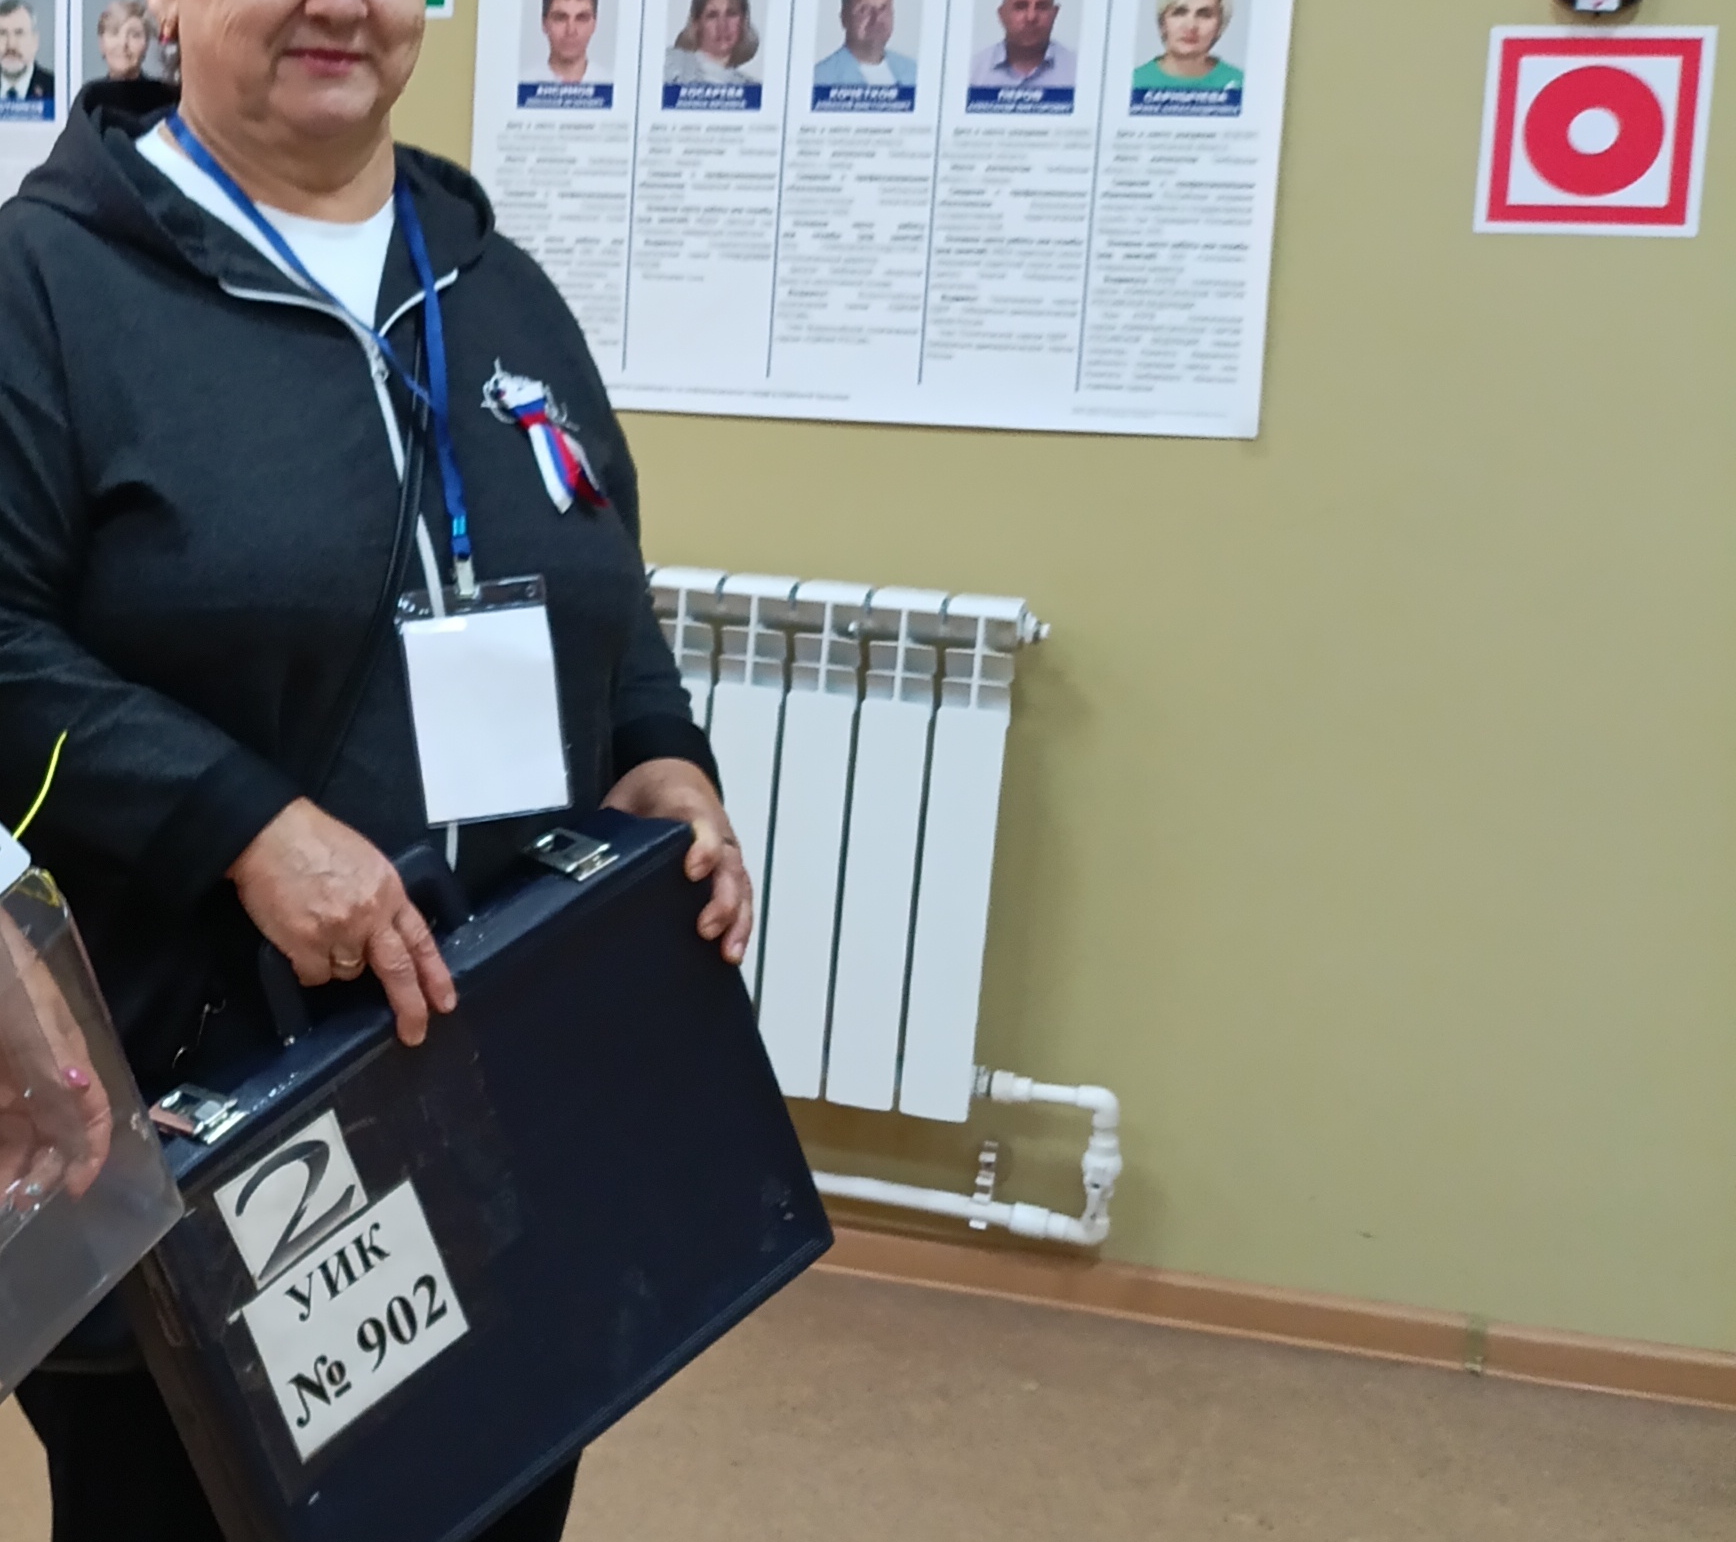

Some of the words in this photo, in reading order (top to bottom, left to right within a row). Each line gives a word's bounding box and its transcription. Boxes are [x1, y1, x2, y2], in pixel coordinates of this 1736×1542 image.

[235, 1139, 357, 1281] 2
[284, 1221, 391, 1322] УИК
[287, 1354, 352, 1428] №
[357, 1273, 448, 1373] 902
